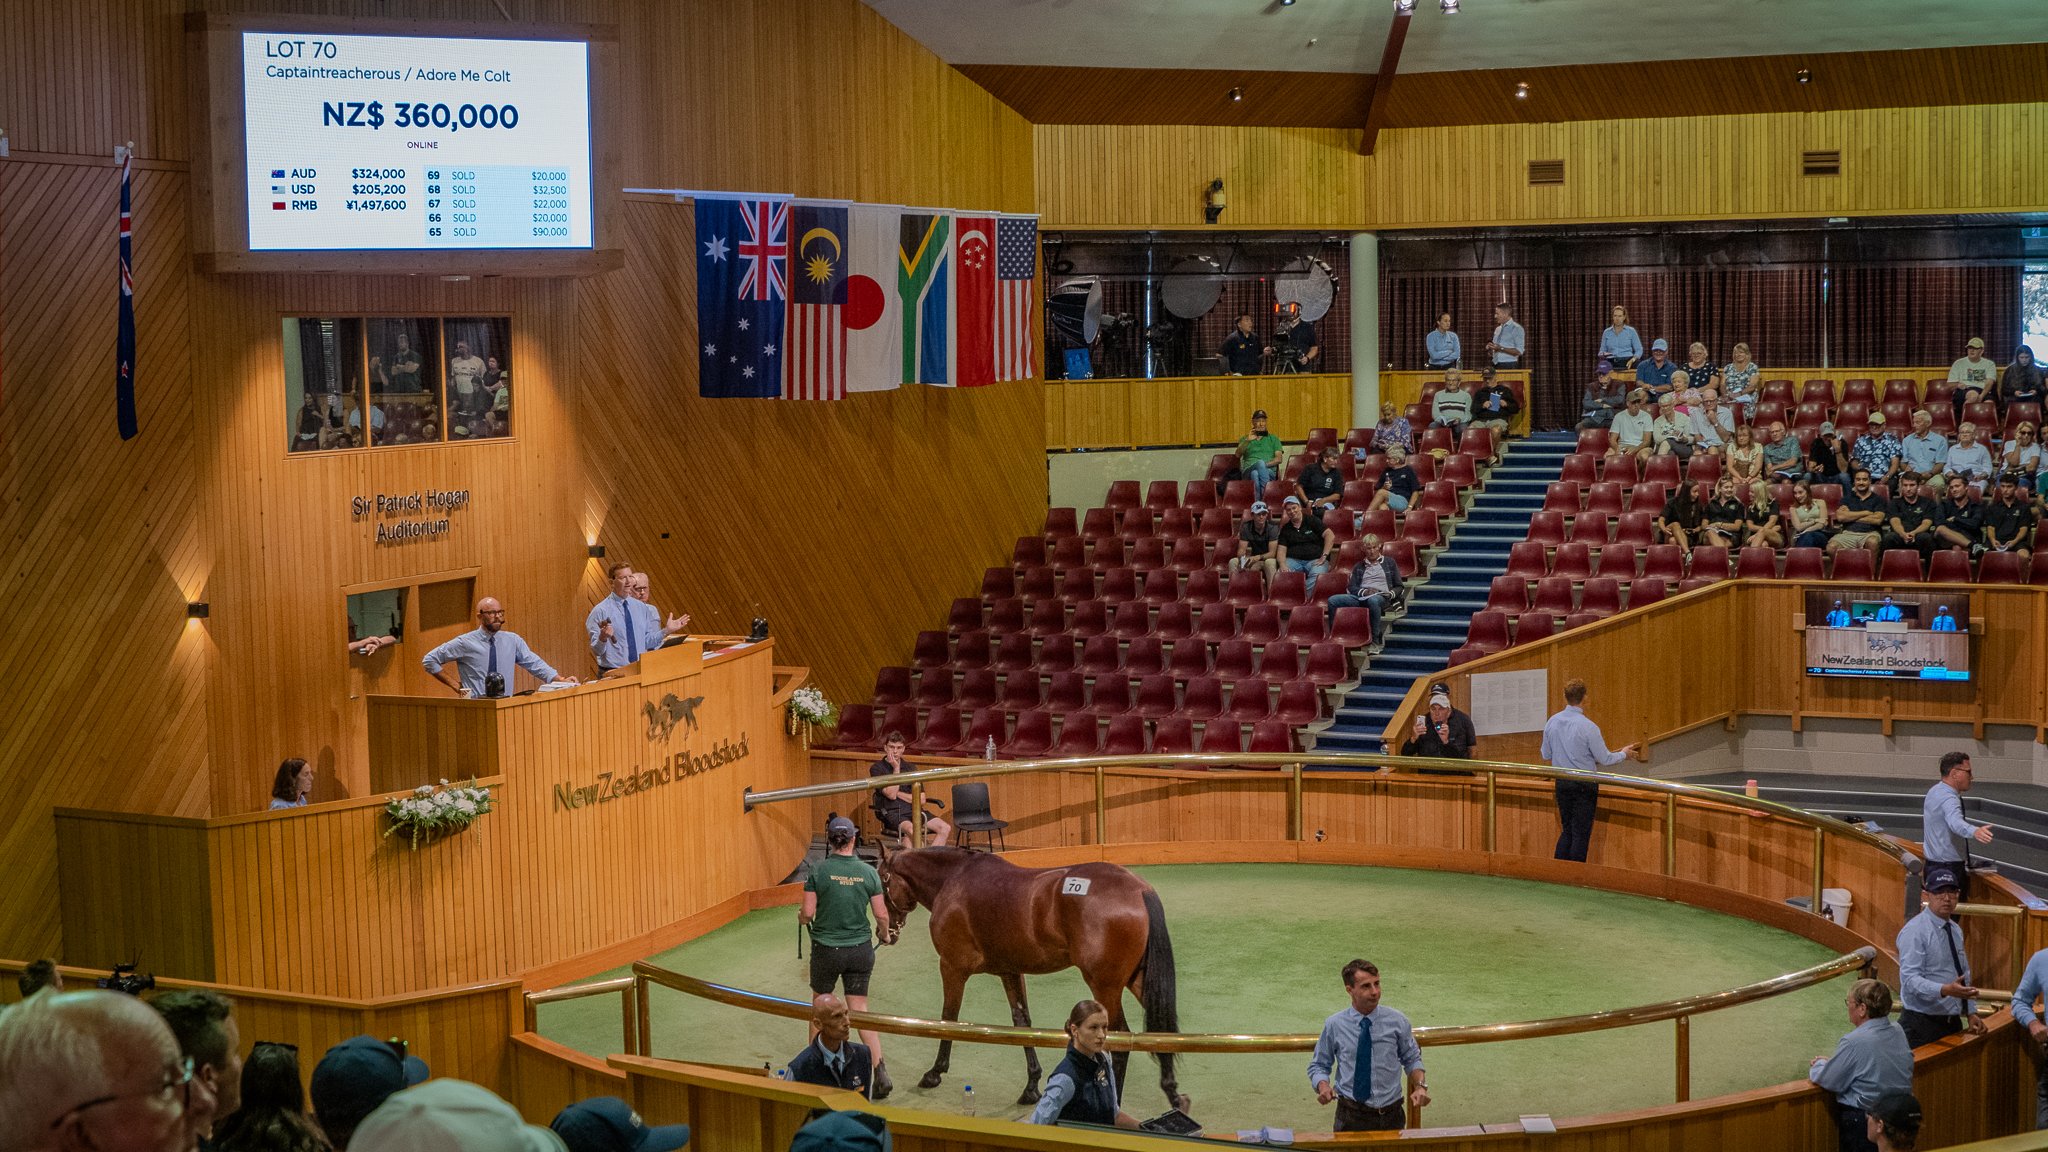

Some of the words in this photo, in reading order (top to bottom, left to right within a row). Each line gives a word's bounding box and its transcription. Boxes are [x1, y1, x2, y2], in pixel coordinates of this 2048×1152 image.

[266, 40, 305, 58] LOT
[312, 41, 337, 59] 70
[266, 65, 401, 80] Captaintreacherous
[404, 67, 412, 82] /
[415, 68, 457, 81] Adore
[461, 69, 480, 82] Me
[484, 70, 511, 82] Colt
[323, 100, 385, 130] NZ$
[394, 102, 519, 132] 360,000
[407, 141, 439, 149] ONLINE
[291, 168, 317, 179] AUD
[351, 168, 406, 180] $324,000
[427, 170, 440, 180] 69
[451, 171, 476, 181] SOLD
[531, 171, 567, 181] $20,000
[291, 184, 316, 195] USD
[352, 184, 407, 196] $205,200
[427, 185, 441, 195] 68
[452, 185, 476, 195] SOLD
[533, 185, 567, 195] $32,500
[292, 200, 318, 211] RMB
[346, 200, 407, 212] ¥1,497,600
[428, 199, 441, 209] 67
[452, 199, 476, 209] SOLD
[533, 199, 567, 209] $22,000
[428, 213, 442, 223] 66
[453, 213, 477, 223] SOLD
[532, 213, 568, 223] $20,000
[429, 227, 442, 237] 65
[453, 227, 477, 237] SOLD
[532, 227, 568, 237] $90,000
[353, 496, 372, 516] Sir
[376, 490, 423, 513] Patrick
[426, 488, 470, 510] Hogan
[375, 517, 450, 542] Auditorium
[1886, 656, 1946, 668] Bloodstock
[674, 732, 750, 782] Bloodstock
[1068, 883, 1082, 893] 70
